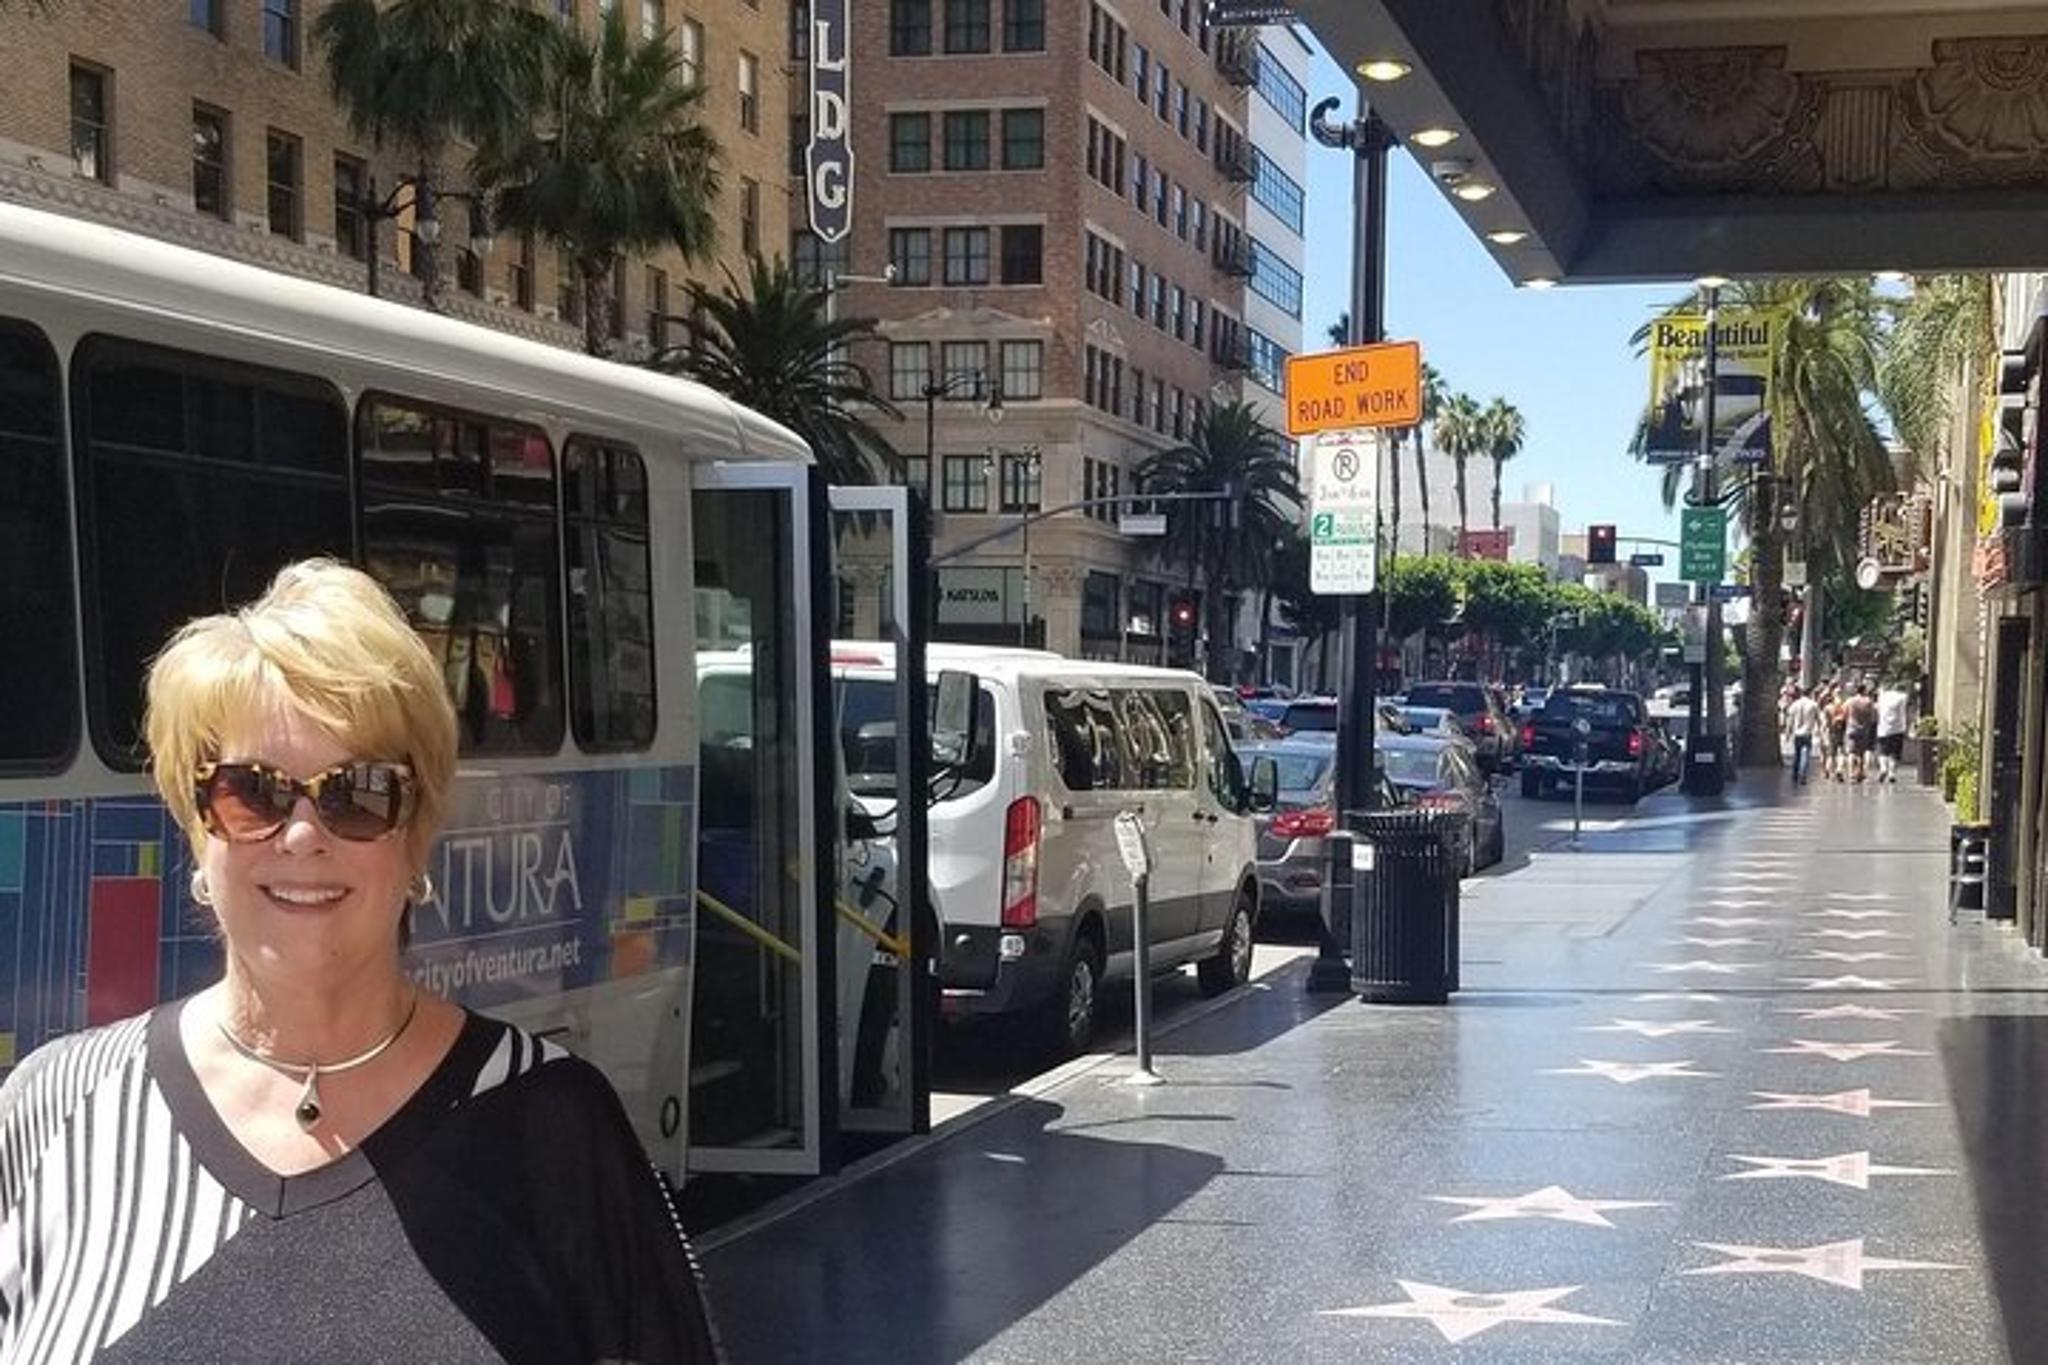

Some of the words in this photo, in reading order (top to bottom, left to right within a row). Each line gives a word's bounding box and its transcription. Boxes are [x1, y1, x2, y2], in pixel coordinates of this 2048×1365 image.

[1333, 360, 1369, 386] END
[1299, 397, 1346, 422] ROAD
[1357, 388, 1409, 416] WORK
[1316, 517, 1330, 535] 2
[486, 785, 533, 820] CITY
[545, 783, 572, 816] OF
